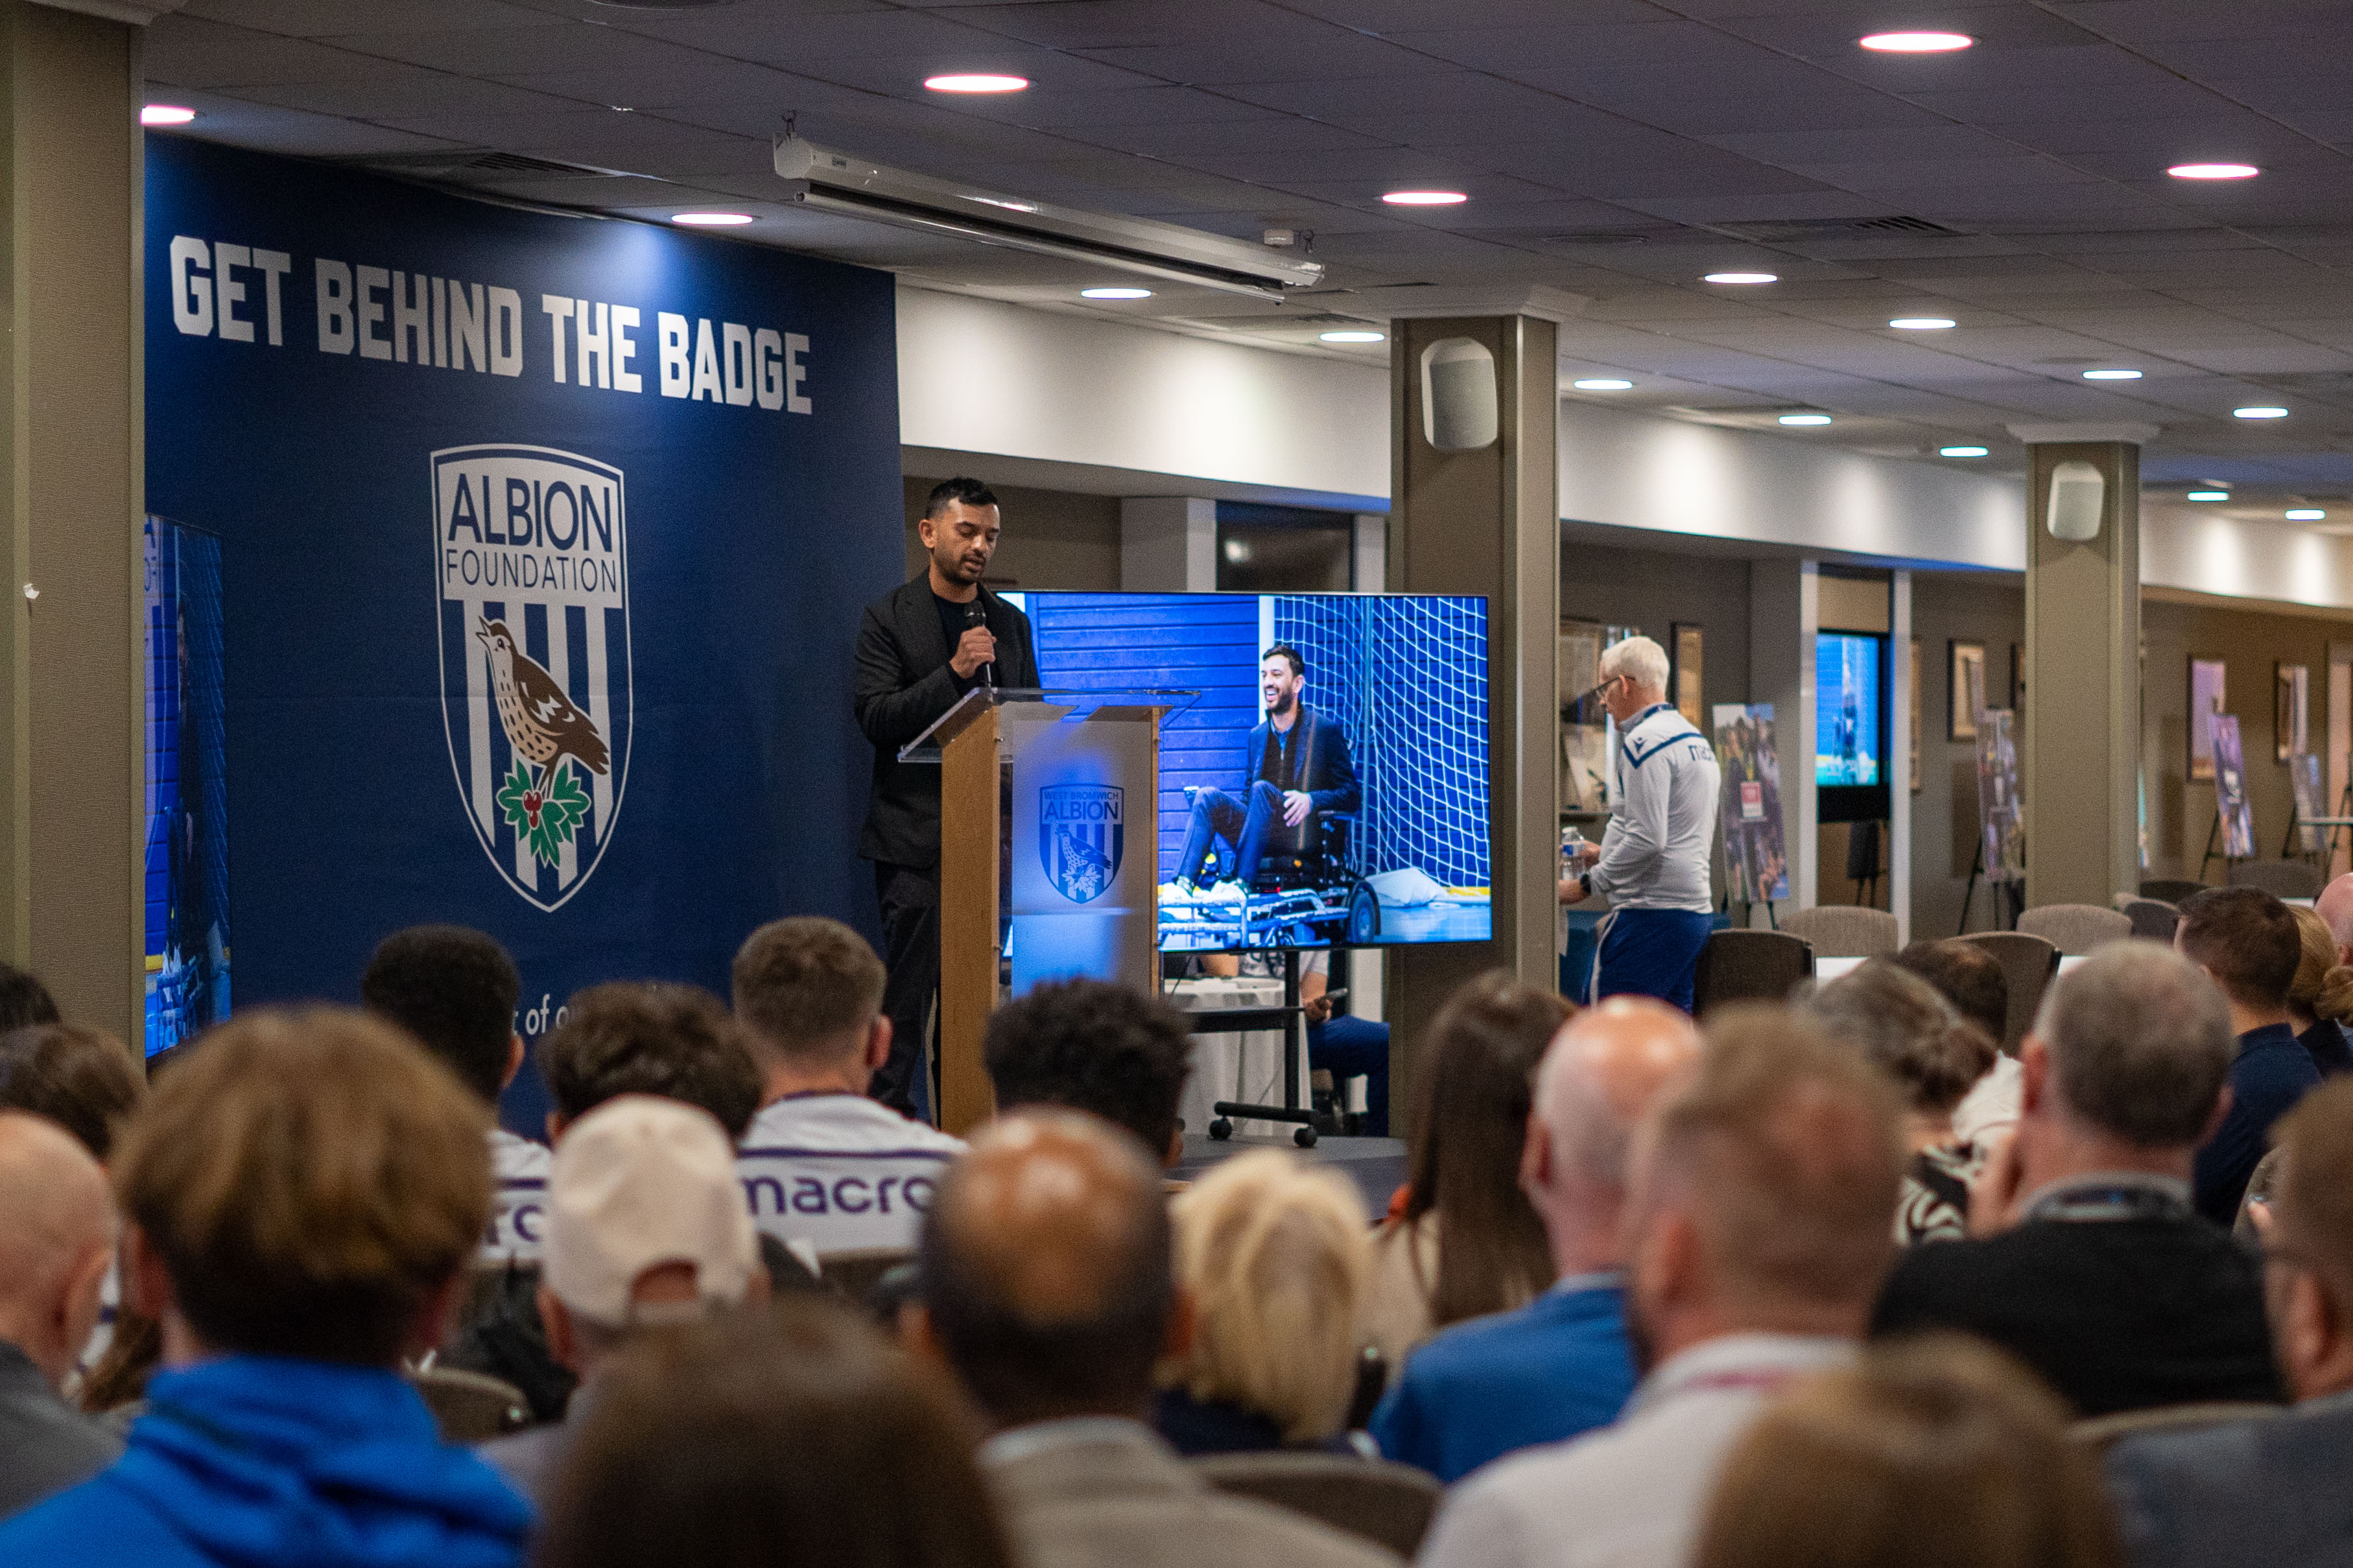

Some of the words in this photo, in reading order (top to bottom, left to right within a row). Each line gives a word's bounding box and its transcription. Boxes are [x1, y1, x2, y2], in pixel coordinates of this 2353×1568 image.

[170, 235, 291, 347] GET
[315, 257, 523, 378] BEHIND
[541, 294, 643, 394] THE
[657, 311, 813, 415] BADGE
[448, 473, 613, 552] ALBION
[447, 548, 617, 593] FOUNDATION
[1044, 791, 1069, 801] WEST
[1071, 791, 1119, 801] BROMWICH
[1044, 801, 1118, 821] ALBION
[525, 993, 550, 1036] of
[739, 1175, 934, 1215] macro
